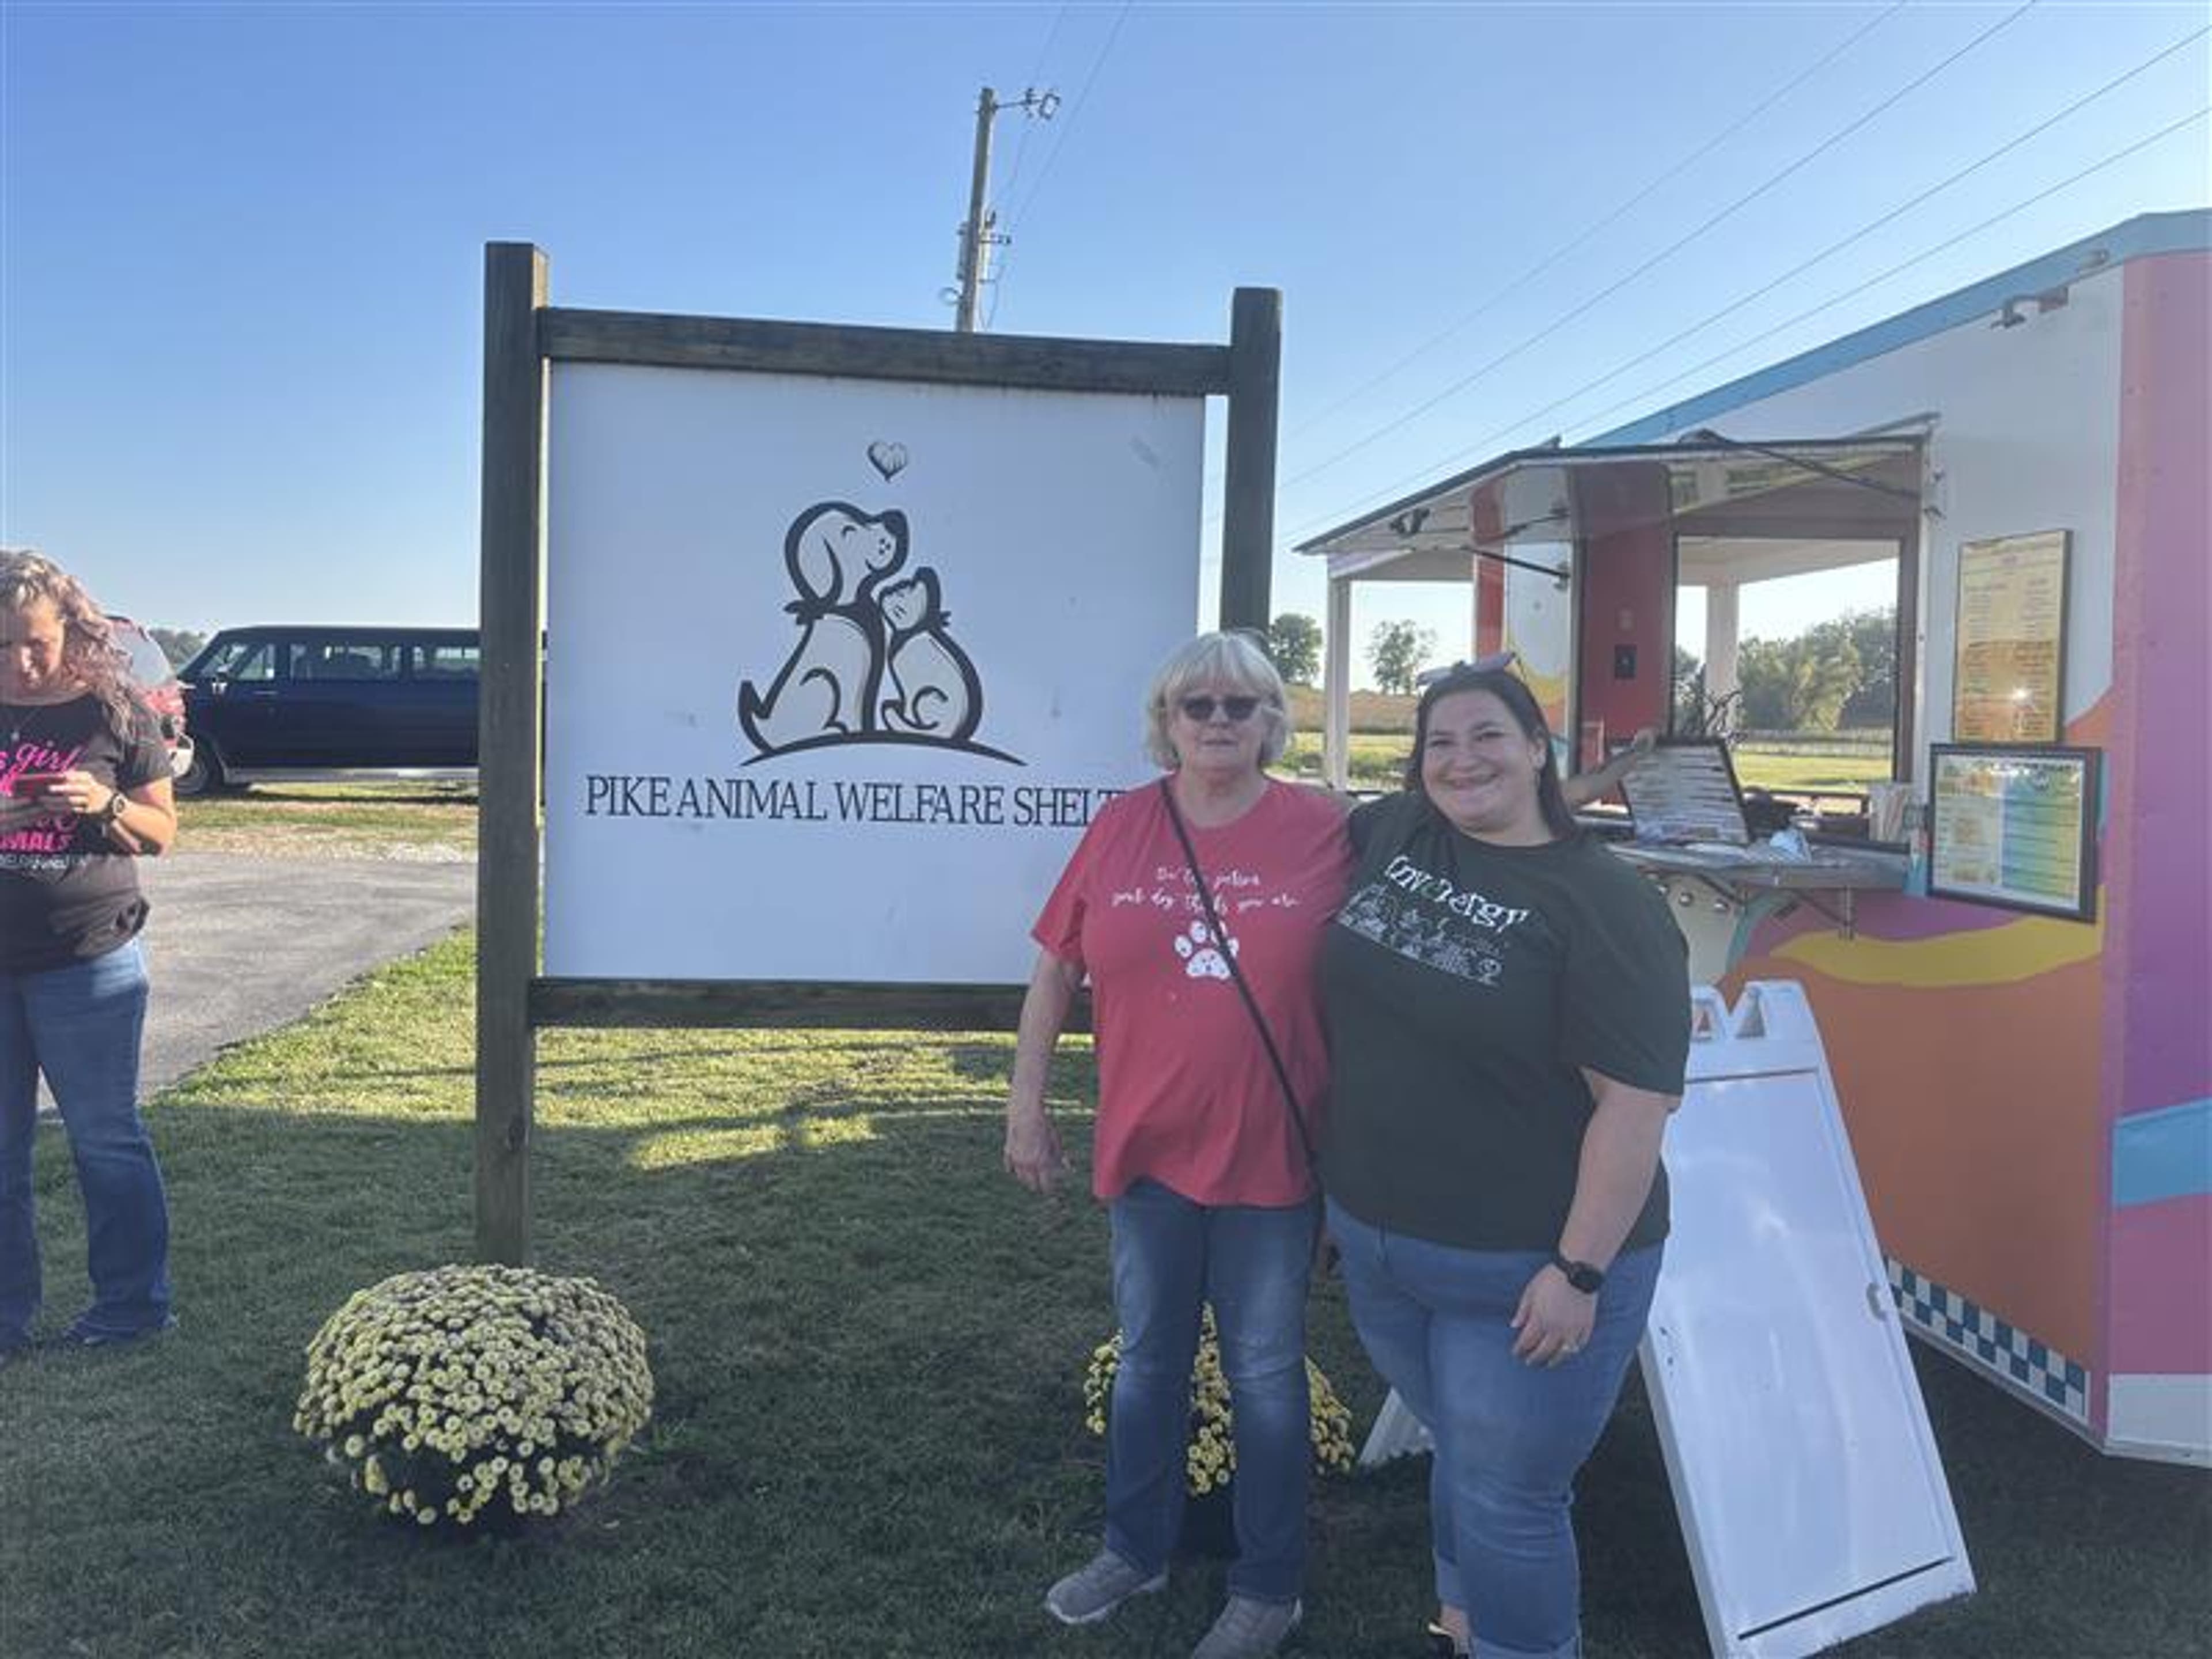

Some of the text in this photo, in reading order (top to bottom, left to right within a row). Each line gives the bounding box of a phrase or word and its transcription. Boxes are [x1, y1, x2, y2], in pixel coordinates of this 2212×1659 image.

[586, 775, 1126, 827] PIKE ANIMAL WELFARE SHEL
